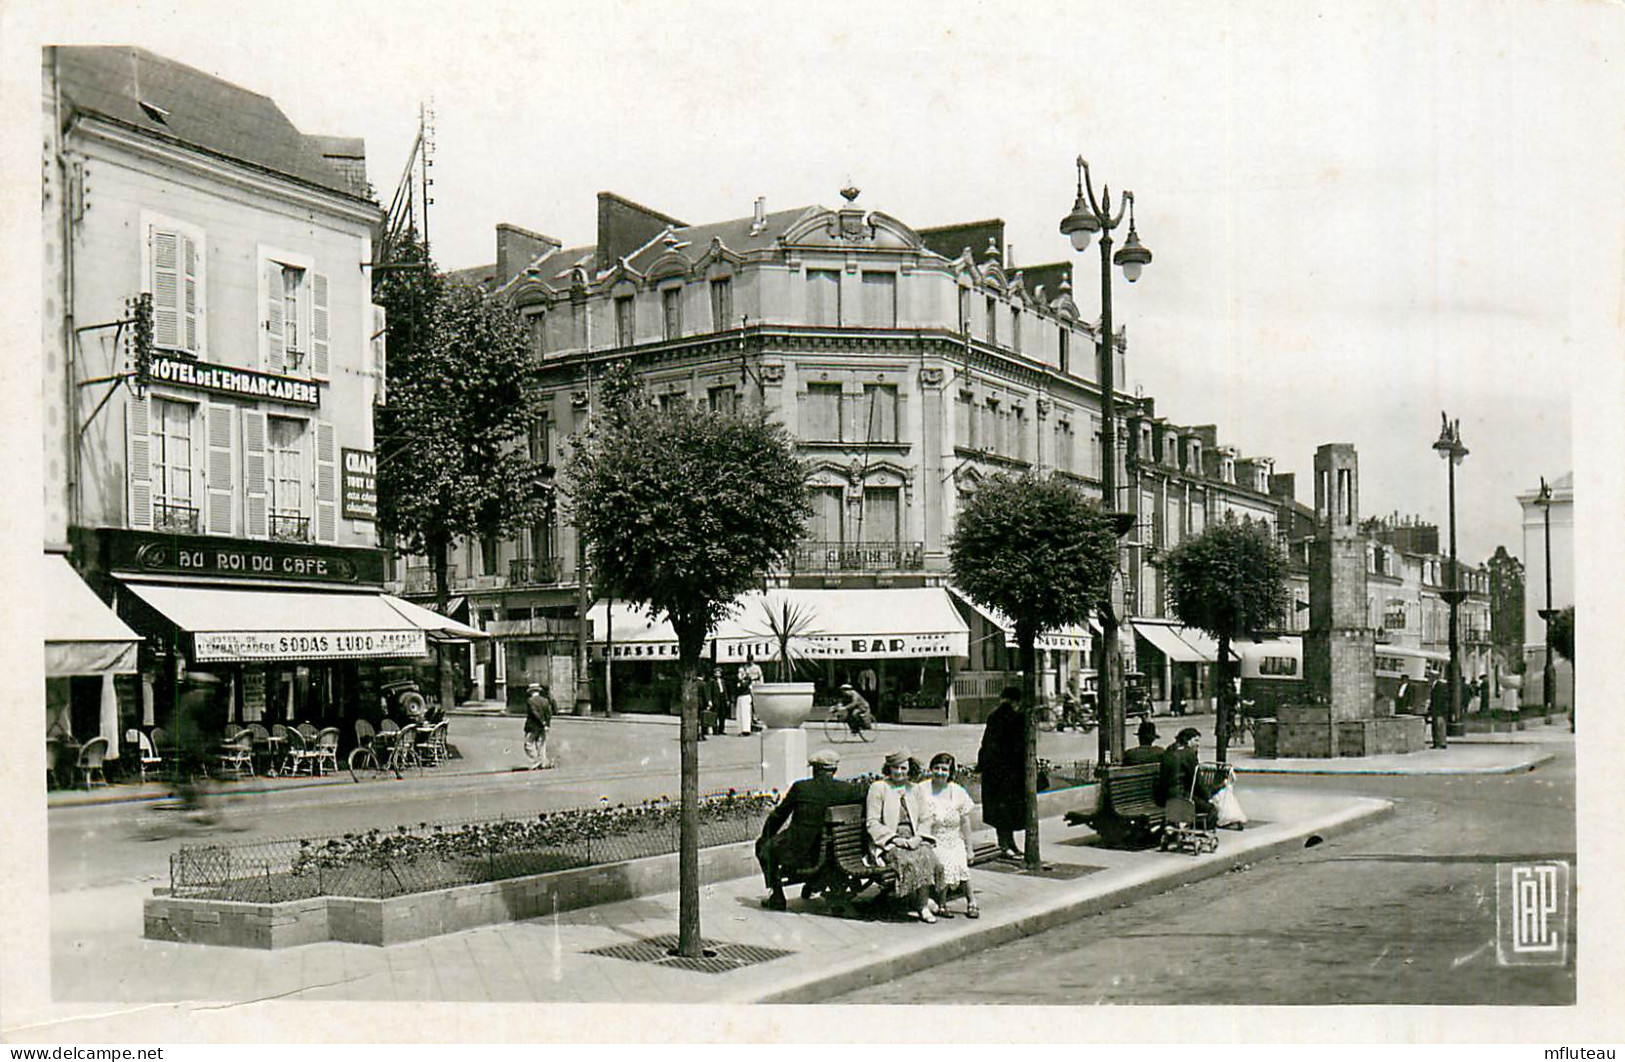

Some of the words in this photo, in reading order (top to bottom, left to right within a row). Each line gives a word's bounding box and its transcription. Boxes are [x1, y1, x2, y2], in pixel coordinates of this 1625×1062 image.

[150, 358, 196, 383] HÔTEL
[179, 551, 204, 567] AU
[217, 553, 246, 570] ROI
[252, 555, 273, 571] DU
[279, 636, 329, 653] SODAS
[336, 635, 374, 652] LUDO
[851, 639, 905, 653] BAR
